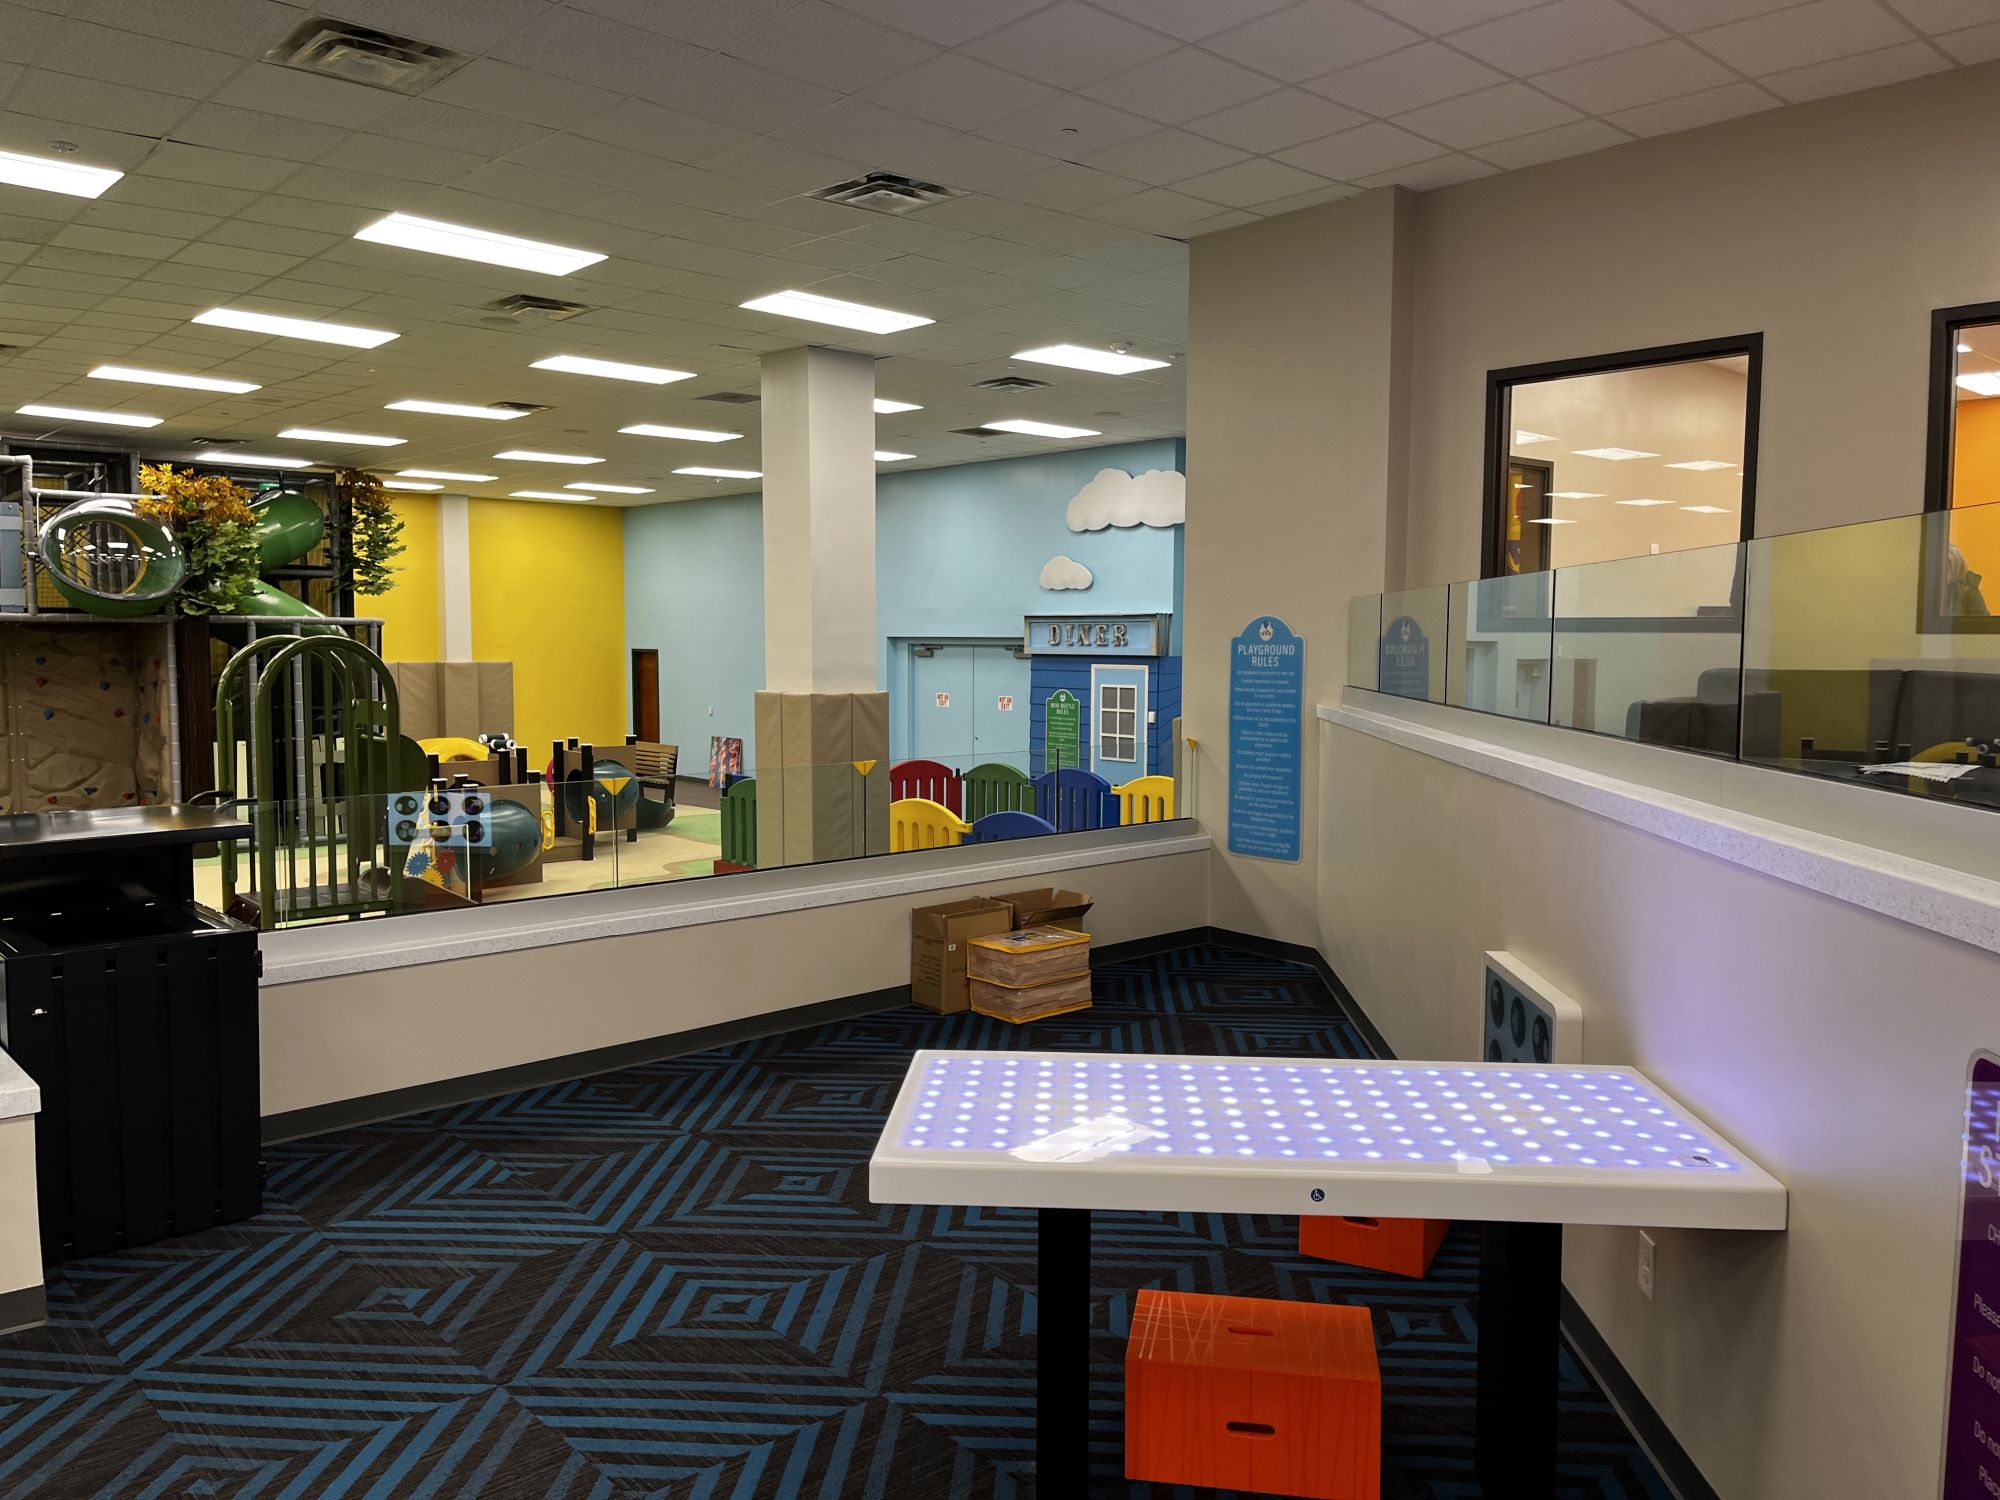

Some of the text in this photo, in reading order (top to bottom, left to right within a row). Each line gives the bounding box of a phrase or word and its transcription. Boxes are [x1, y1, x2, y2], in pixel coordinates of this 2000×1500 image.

[1048, 623, 1128, 647] DINER
[1237, 644, 1295, 656] PLAYGROUND
[1251, 656, 1280, 668] RULES
[1973, 1355, 1985, 1379] Do
[1974, 1420, 1986, 1444] Do
